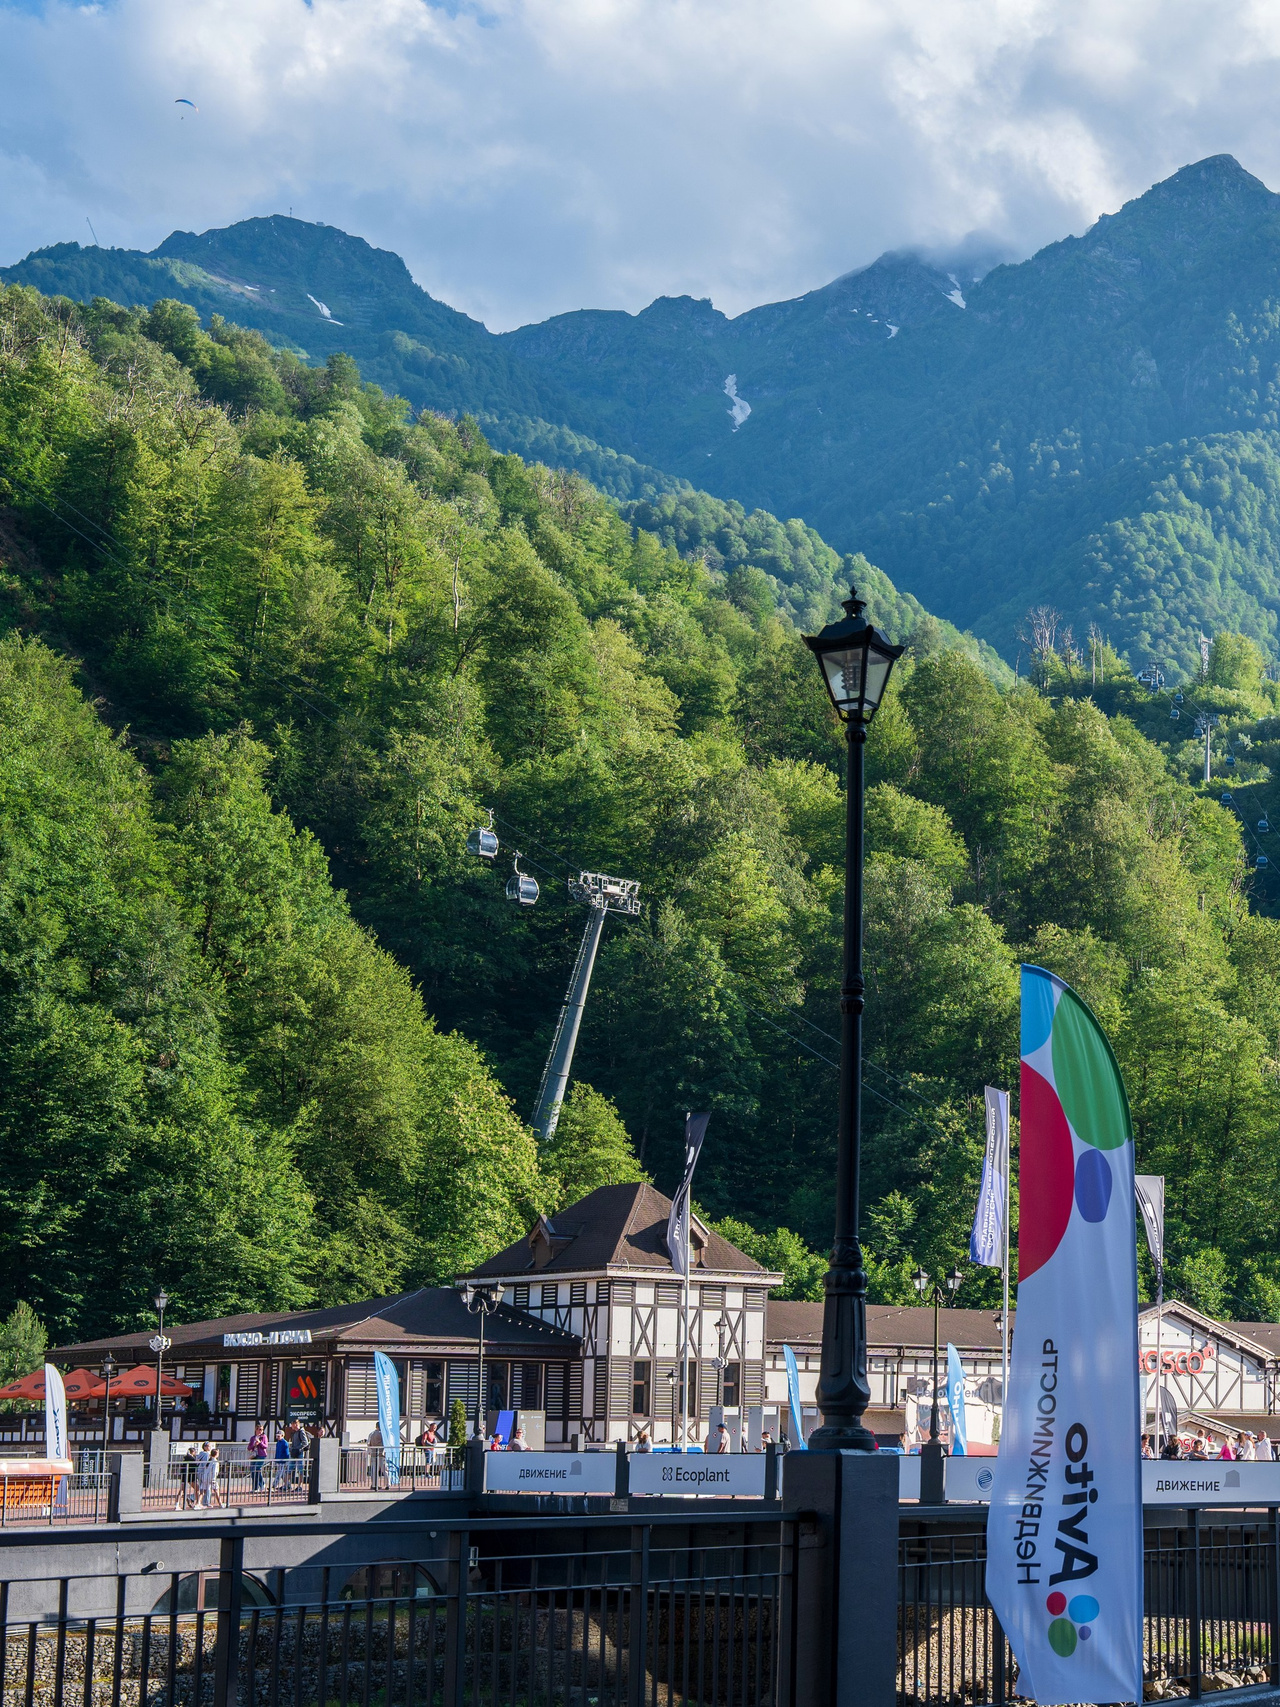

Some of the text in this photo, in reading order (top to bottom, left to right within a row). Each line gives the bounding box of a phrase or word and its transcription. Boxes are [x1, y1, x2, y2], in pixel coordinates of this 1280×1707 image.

[981, 1198, 991, 1248] ГЛАВНЫЙ
[987, 1211, 996, 1249] ФОРУМ
[223, 1332, 263, 1347] ВКУСНО
[269, 1332, 279, 1344] И
[279, 1330, 313, 1344] ТОЧКА
[518, 1467, 567, 1480] ДВИЖЕНИЕ
[676, 1467, 730, 1486] Ecoplant
[1156, 1480, 1220, 1492] ДВИЖЕНИЕ
